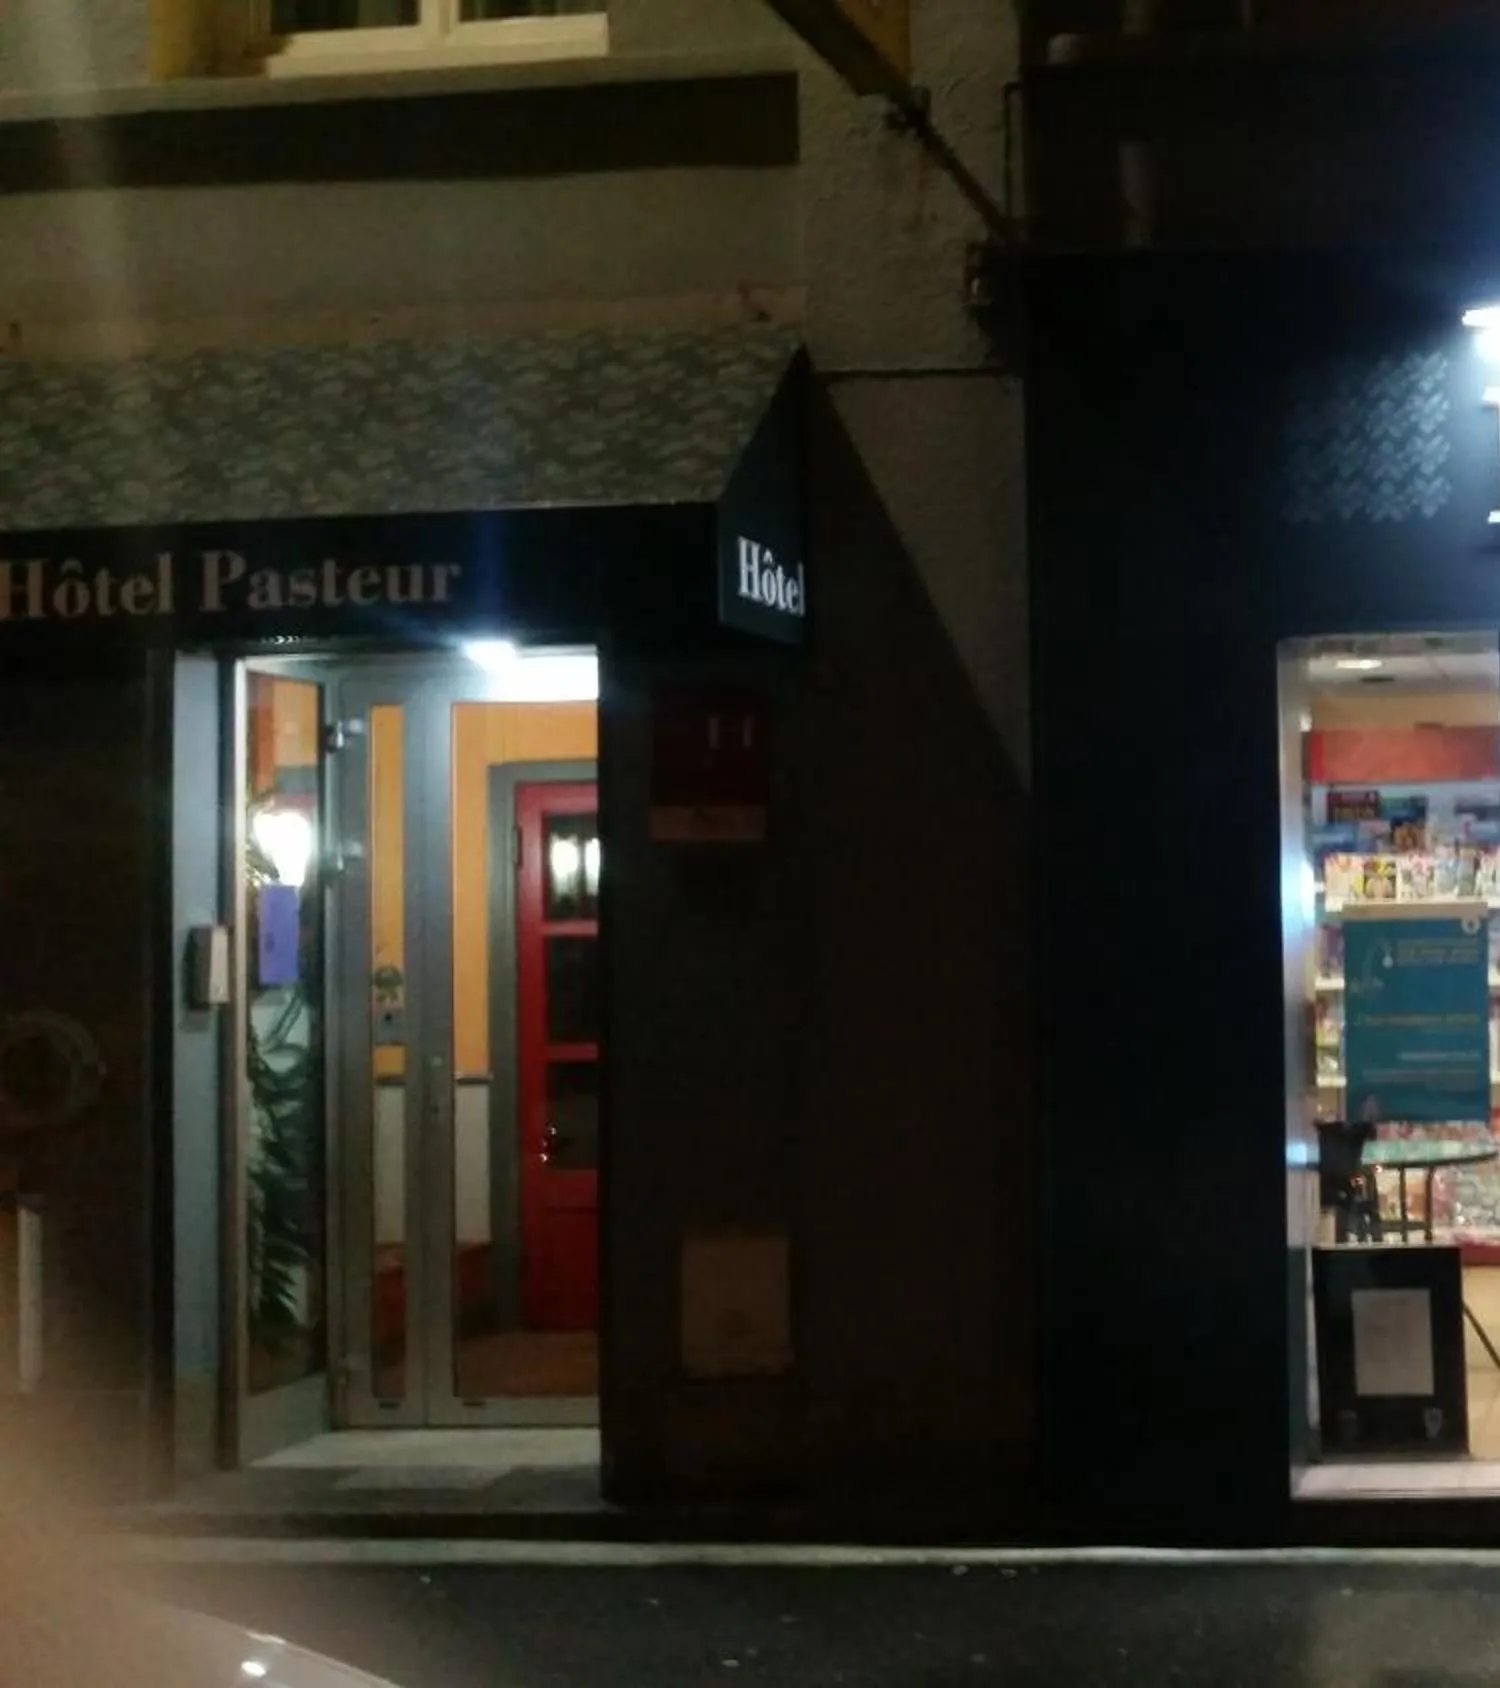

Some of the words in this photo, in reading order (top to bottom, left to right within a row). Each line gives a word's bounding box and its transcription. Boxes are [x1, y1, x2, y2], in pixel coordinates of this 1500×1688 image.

[0, 551, 173, 621] Hôtel
[200, 549, 461, 610] Pasteur
[737, 535, 806, 618] Hôtel
